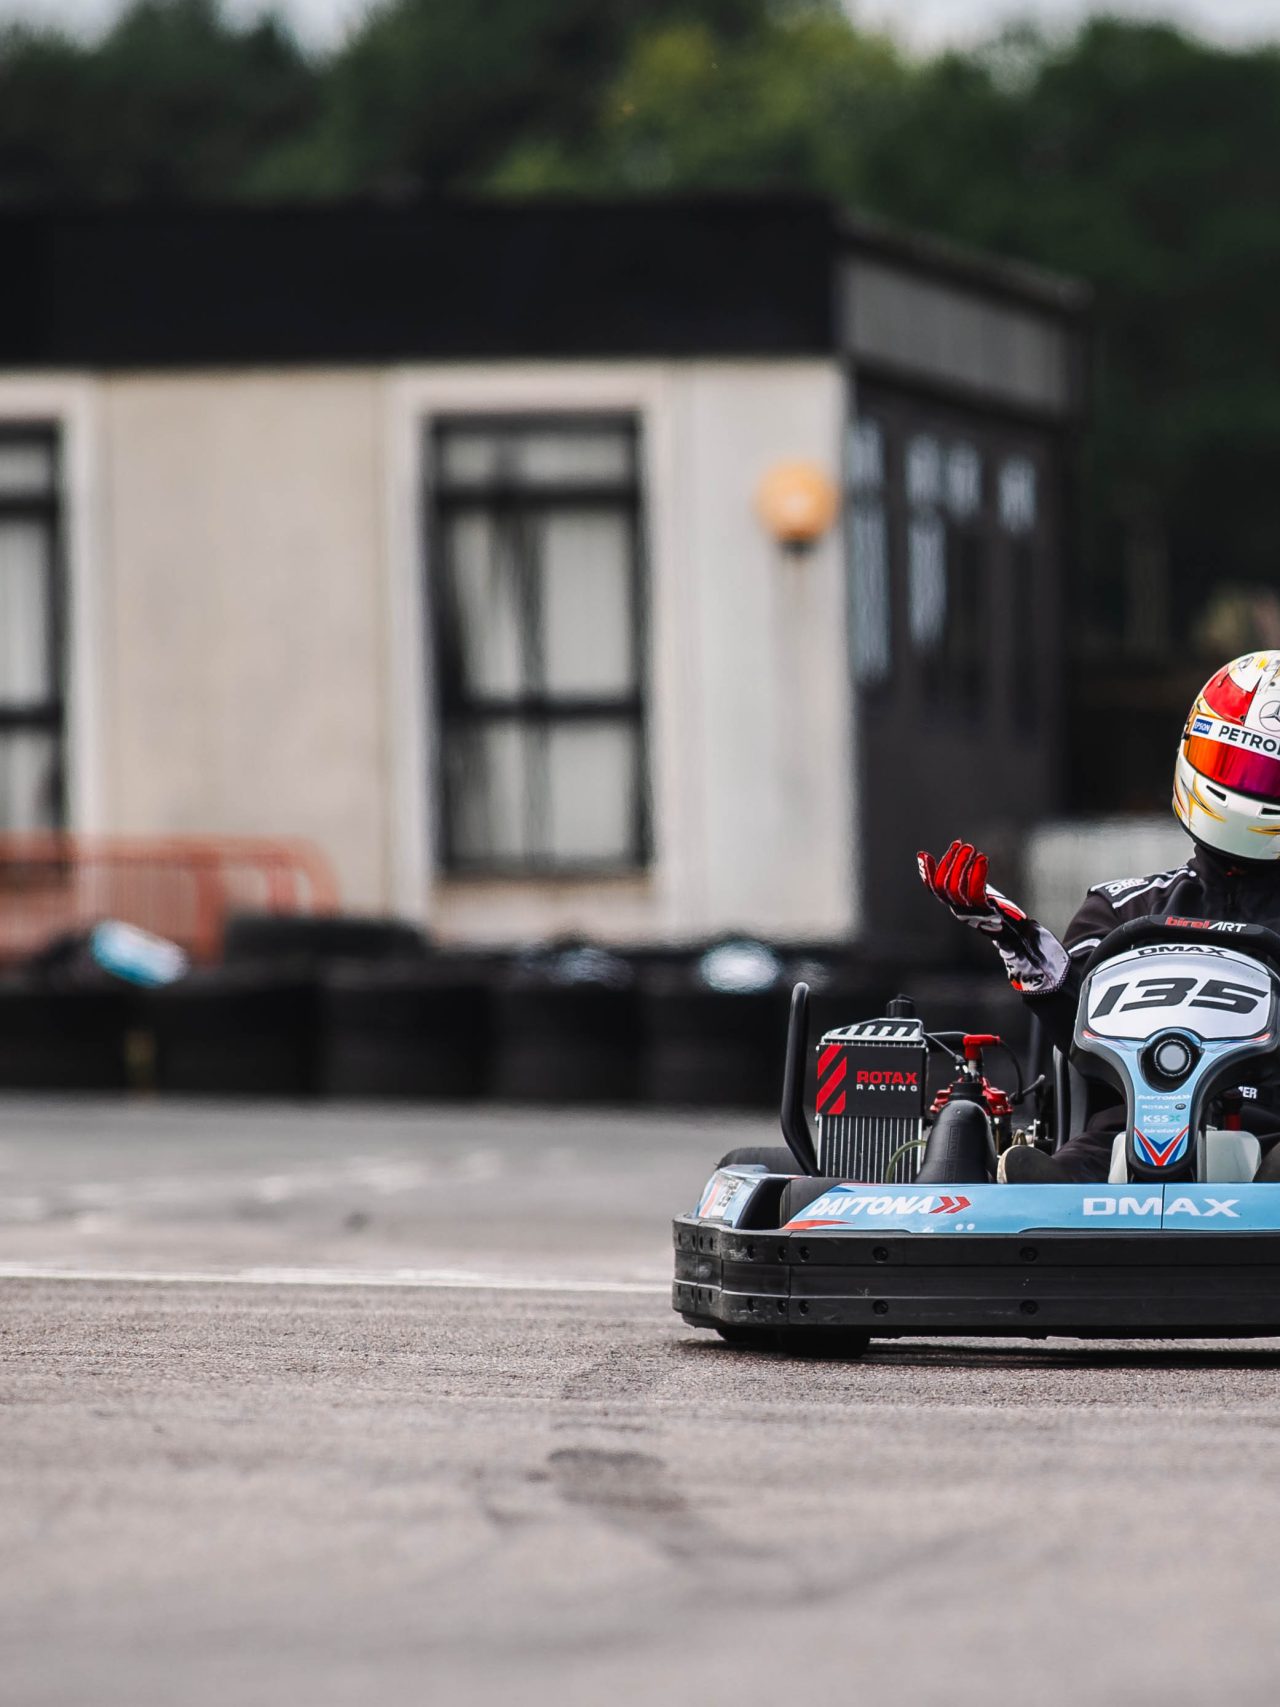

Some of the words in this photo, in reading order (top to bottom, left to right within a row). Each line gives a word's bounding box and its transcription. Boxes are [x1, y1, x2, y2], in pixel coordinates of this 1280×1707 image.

[1137, 946, 1227, 957] DMAX
[1090, 978, 1268, 1019] 135
[857, 1071, 918, 1084] ROTAX
[856, 1083, 918, 1092] RACING
[805, 1196, 933, 1216] DAYTONA
[1083, 1197, 1241, 1218] DMAX
